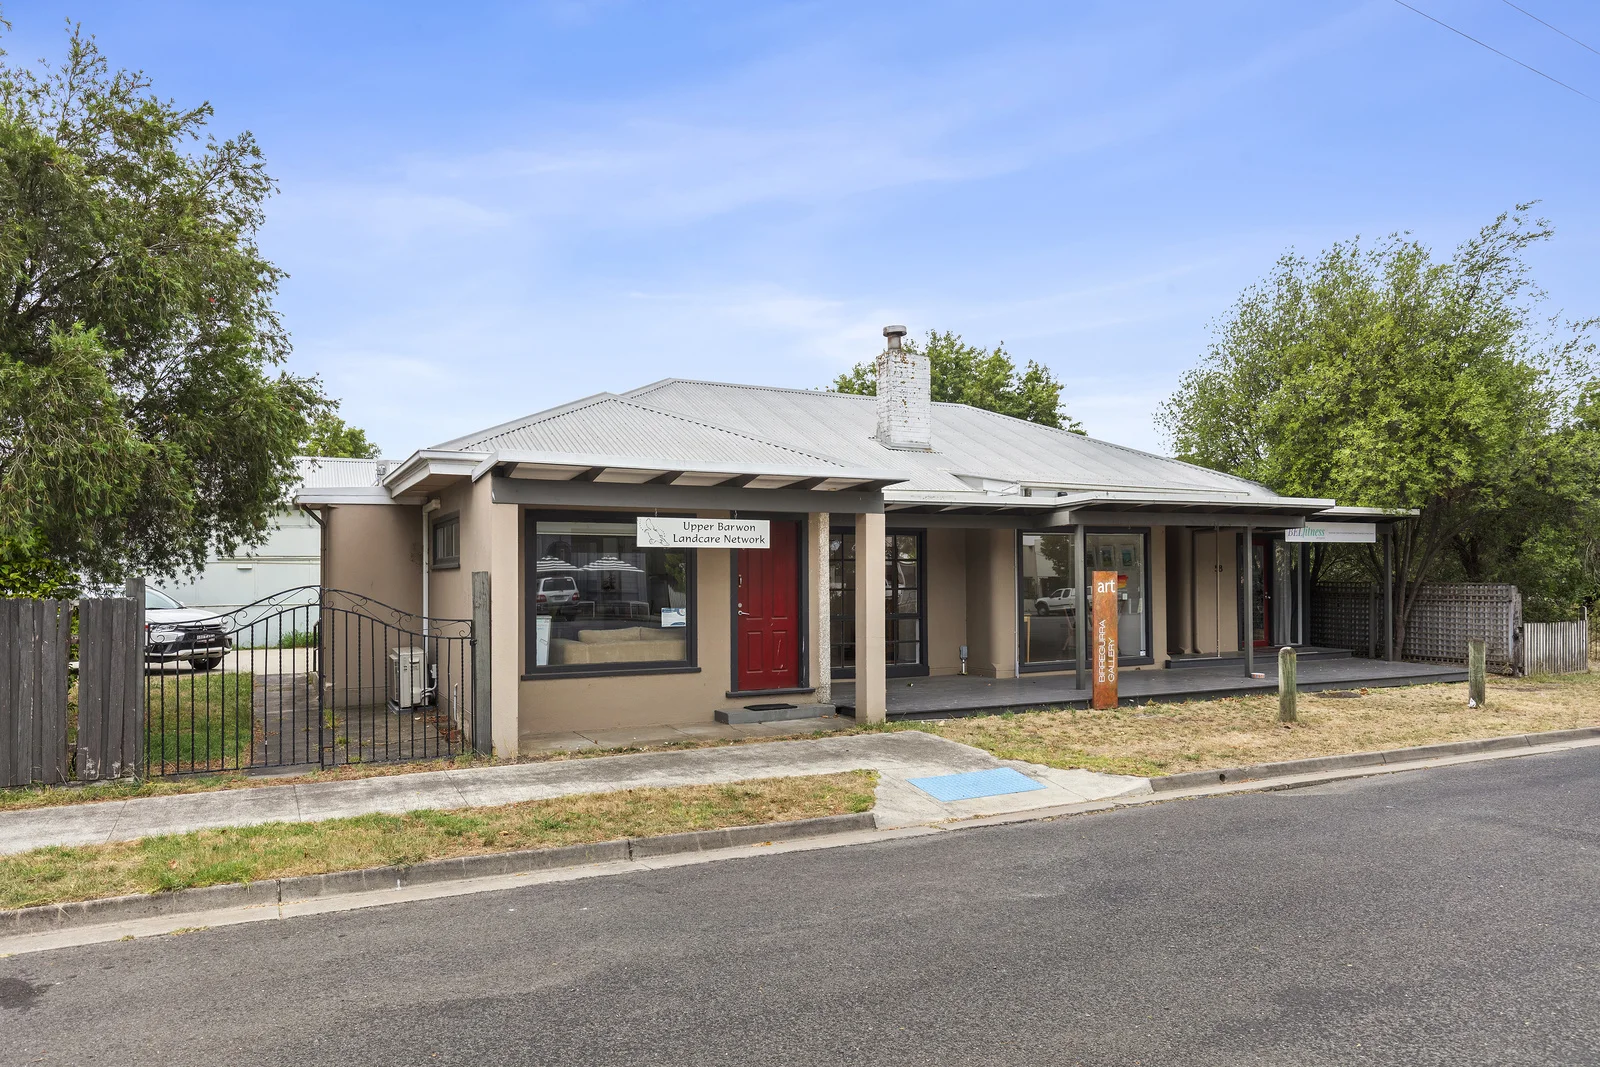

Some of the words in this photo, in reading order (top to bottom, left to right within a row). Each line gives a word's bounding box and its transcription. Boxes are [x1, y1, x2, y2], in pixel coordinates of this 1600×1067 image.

[683, 521, 714, 533] Upper
[717, 522, 756, 532] Barwon
[673, 533, 721, 544] Landcare
[723, 534, 766, 544] Network
[1097, 579, 1116, 594] art
[1098, 619, 1106, 683] BIRREGURRA
[1107, 637, 1115, 683] GALLERY
